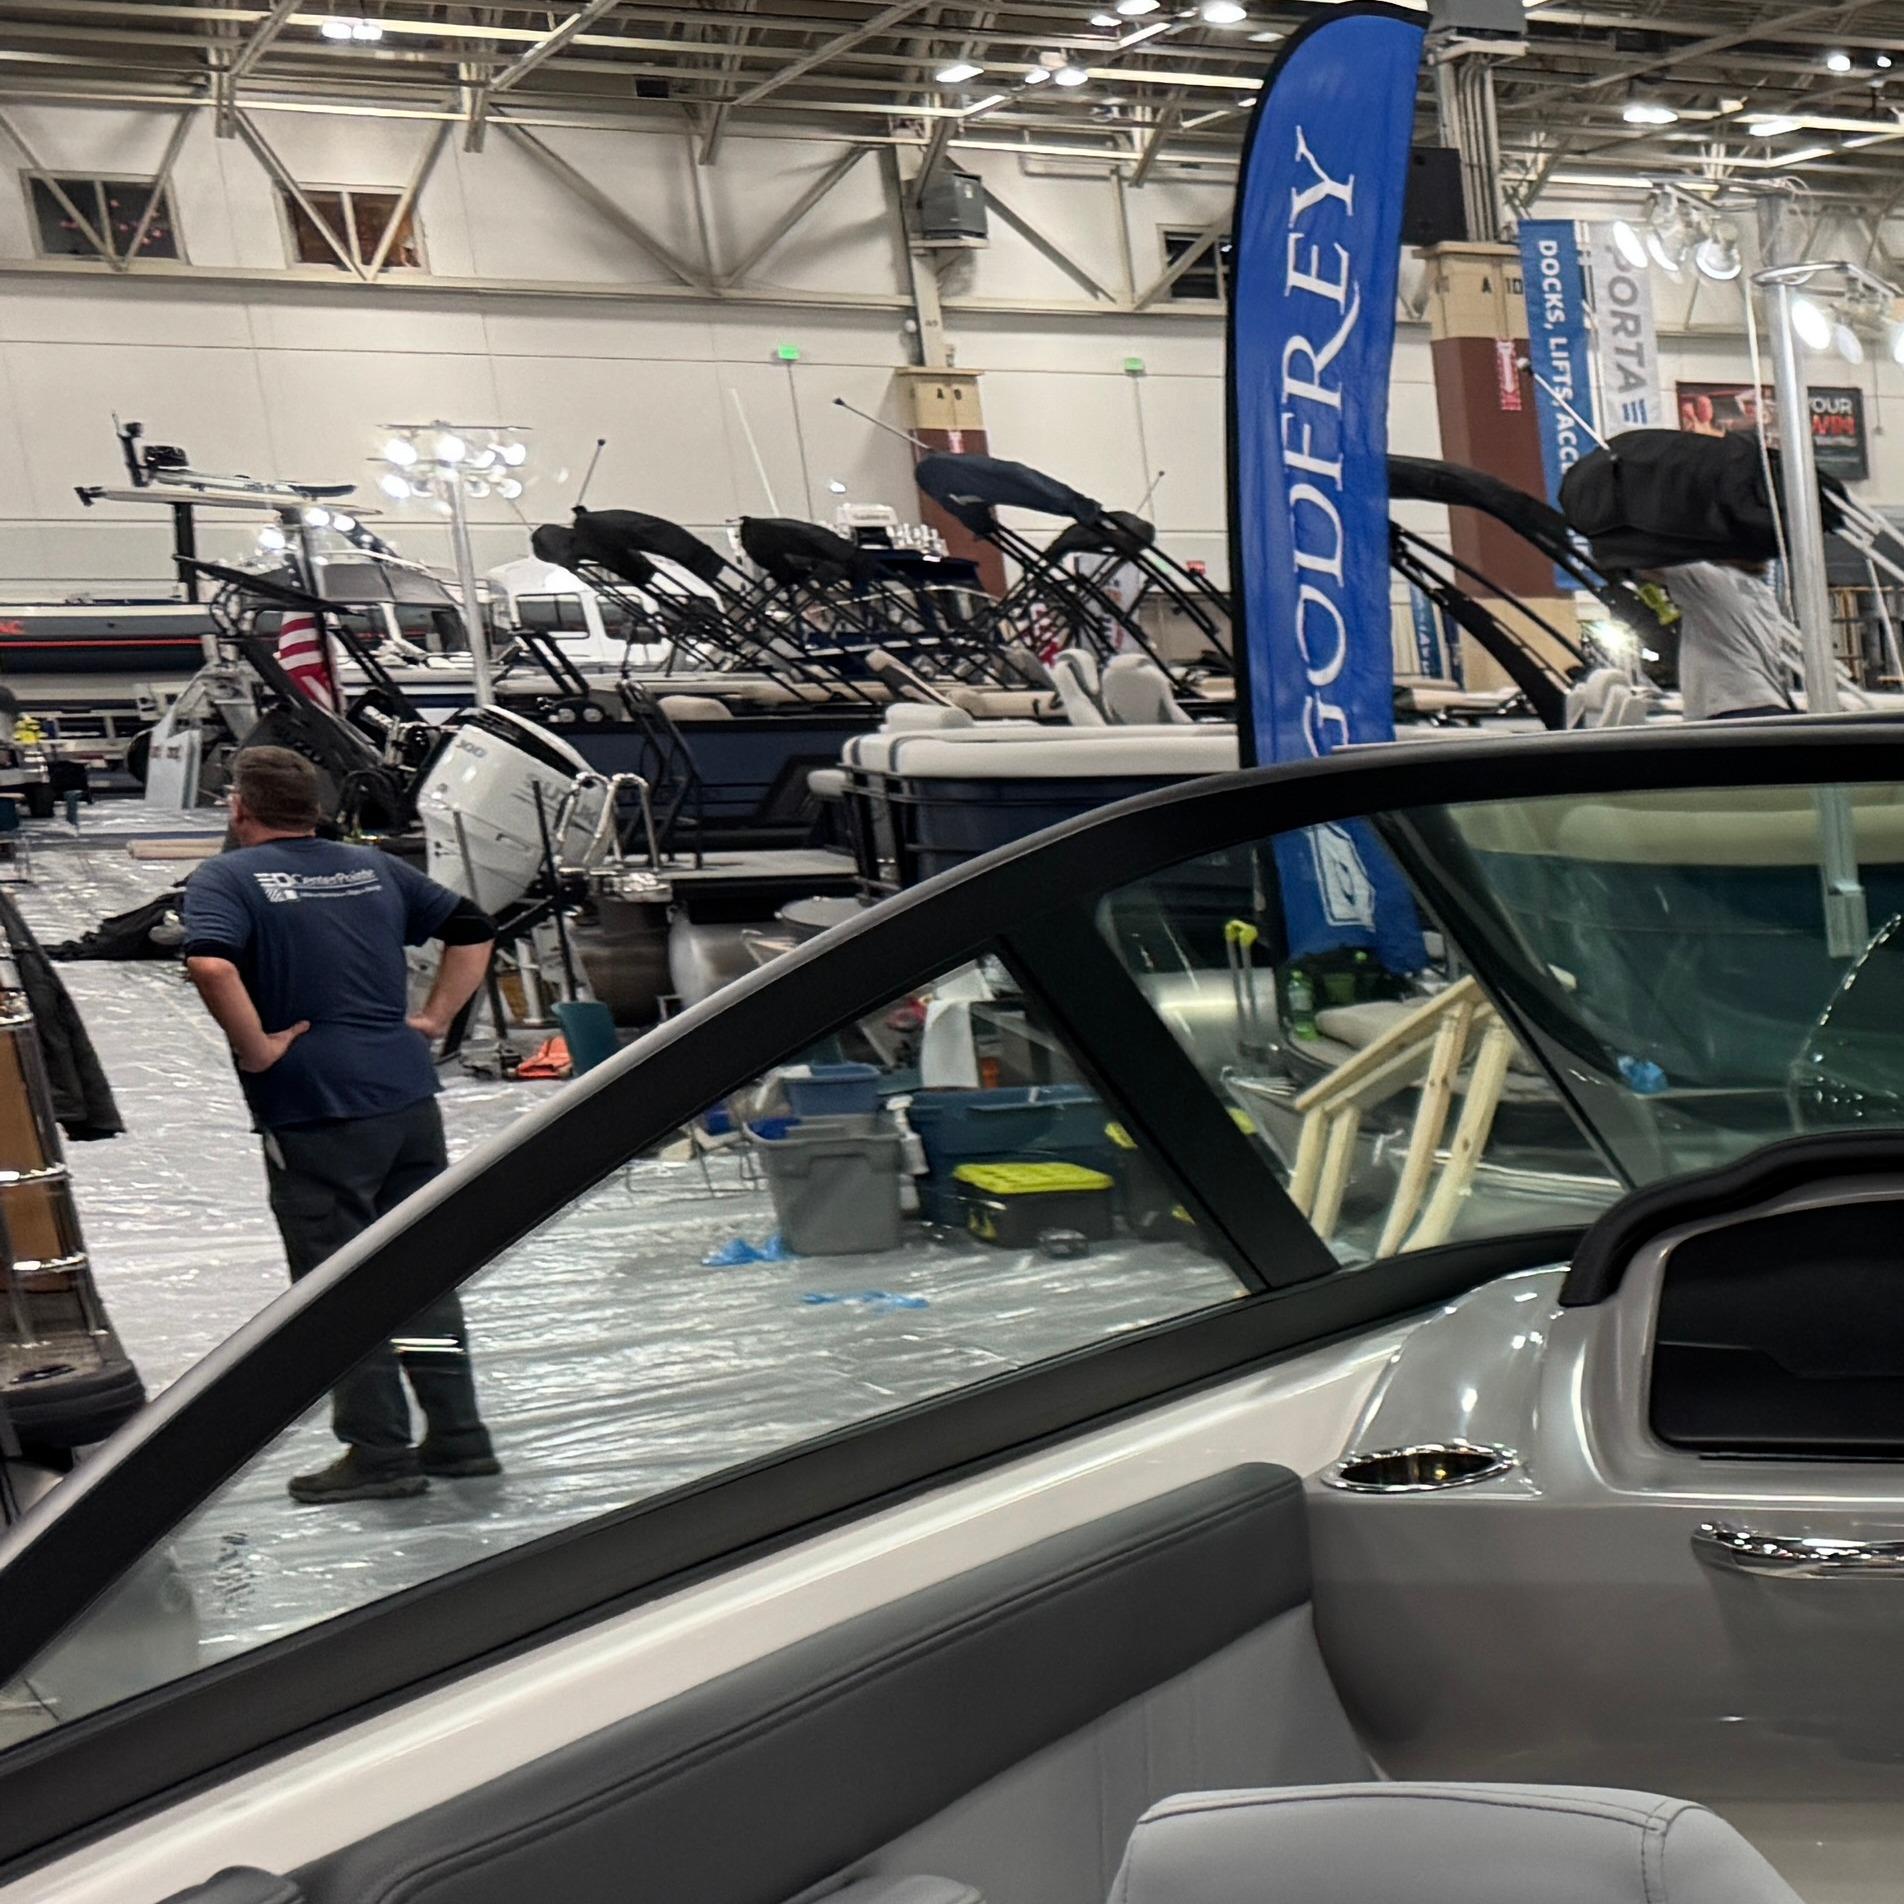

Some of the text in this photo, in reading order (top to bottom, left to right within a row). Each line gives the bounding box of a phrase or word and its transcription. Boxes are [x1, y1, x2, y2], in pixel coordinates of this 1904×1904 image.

[1538, 240, 1566, 330] DOCKS,
[1282, 125, 1361, 759] GODFREY
[1811, 398, 1853, 414] OUR
